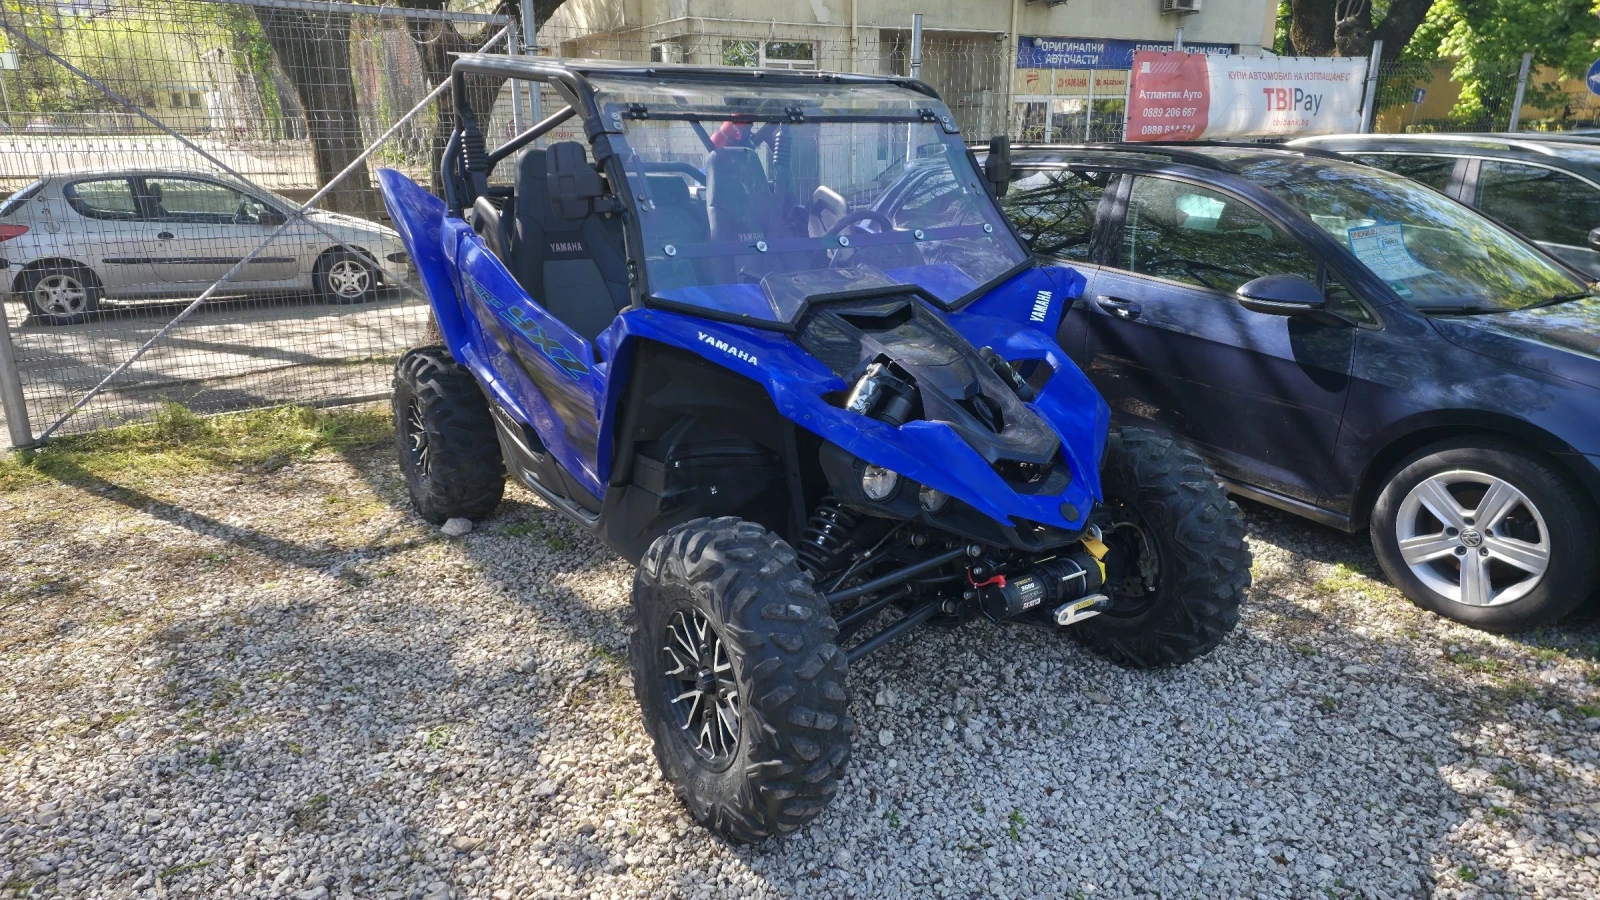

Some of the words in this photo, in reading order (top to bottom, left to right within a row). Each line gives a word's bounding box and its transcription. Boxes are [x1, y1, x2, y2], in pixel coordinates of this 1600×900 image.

[1041, 41, 1104, 52] ОРИГИНАЛНИ
[1045, 54, 1099, 64] АВТОЧАСТИ
[1228, 71, 1247, 80] КУПИ
[1248, 71, 1292, 81] АВТОМОБИЛ
[1293, 73, 1303, 81] НА
[1139, 89, 1182, 99] Атлантик
[1183, 90, 1203, 101] Ауто
[1263, 87, 1323, 116] TBIPay
[1142, 107, 1164, 118] 0889
[1164, 107, 1181, 118] 206
[1182, 107, 1197, 117] 667
[1141, 125, 1163, 135] 0888
[737, 232, 765, 242] YAMAHA
[550, 242, 583, 252] YAMAHA
[1030, 290, 1053, 322] YAMAHA
[698, 331, 758, 366] YAMAHA
